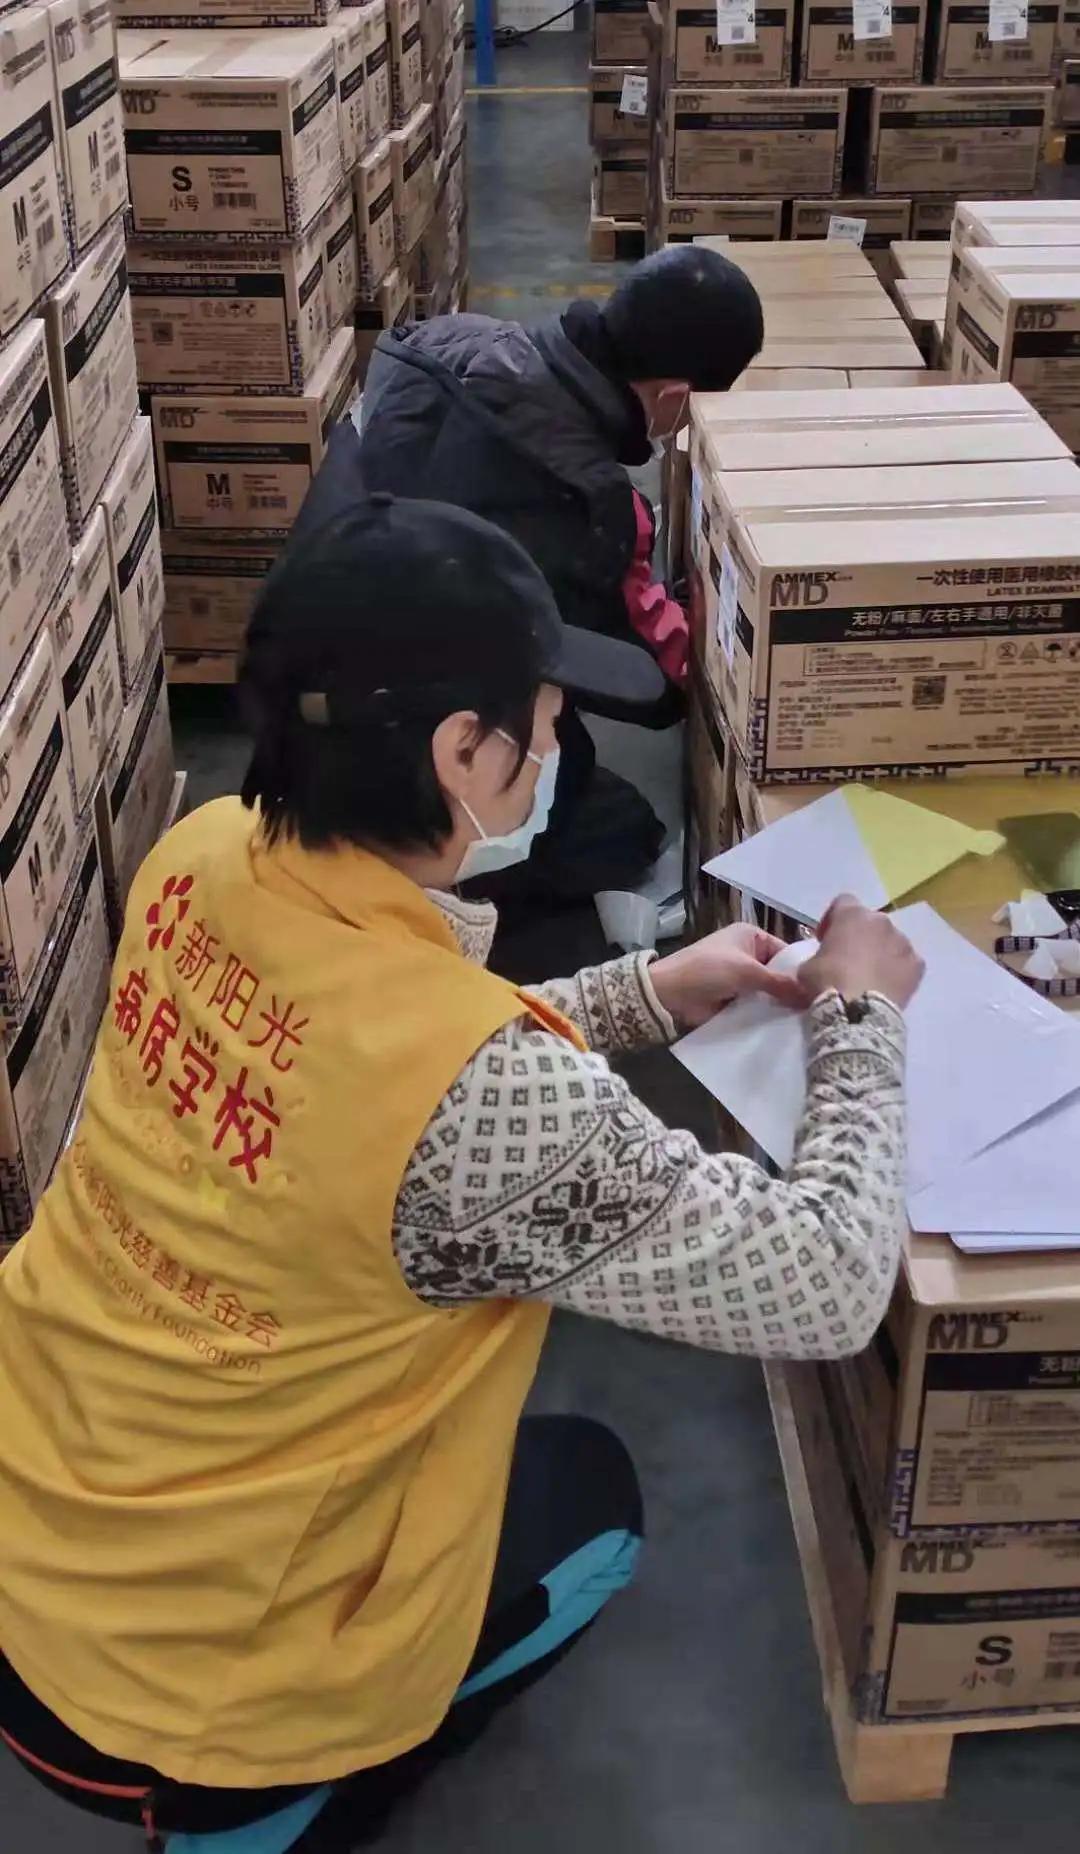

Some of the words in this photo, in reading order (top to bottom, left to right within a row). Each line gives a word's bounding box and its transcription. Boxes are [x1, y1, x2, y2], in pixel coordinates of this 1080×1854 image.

[838, 33, 855, 51] M
[88, 131, 99, 173] M
[172, 165, 193, 192] S
[169, 194, 200, 213] 小号
[12, 196, 28, 245] M
[206, 473, 231, 496] M
[770, 580, 829, 607] MD
[174, 918, 310, 1072] 新阳光
[927, 1322, 1008, 1349] MD
[900, 1548, 975, 1573] MD
[975, 1635, 1014, 1666] S
